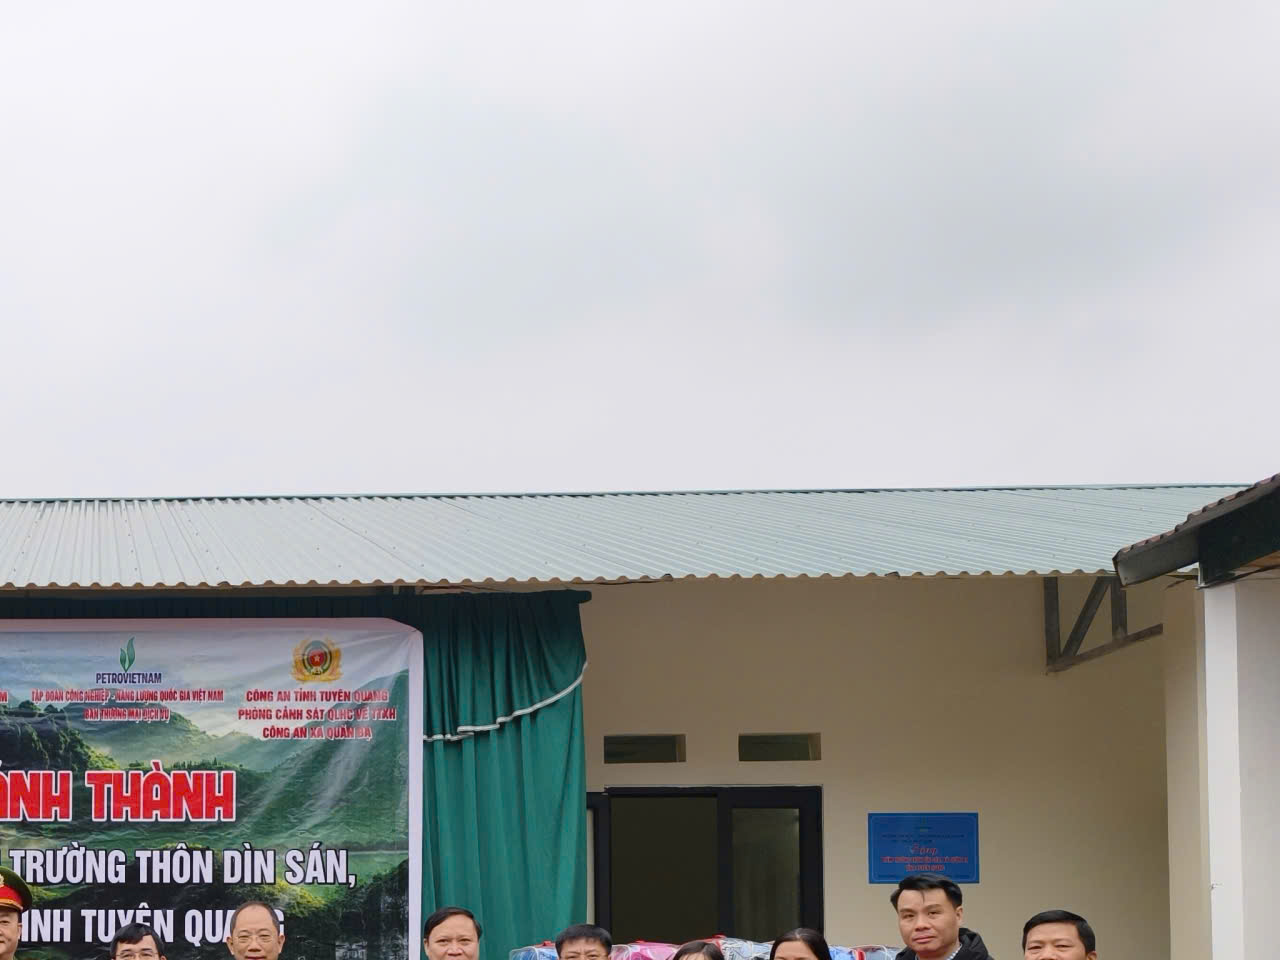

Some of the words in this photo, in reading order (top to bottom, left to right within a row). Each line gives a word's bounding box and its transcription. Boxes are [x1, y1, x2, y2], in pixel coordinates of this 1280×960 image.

[96, 672, 162, 684] PETROVIETNAM
[179, 689, 191, 701] GIA
[207, 689, 224, 701] NAM
[246, 689, 274, 702] CÔNG
[277, 690, 291, 702] AN
[319, 689, 351, 702] TUYÊN
[354, 690, 389, 703] QUANG
[262, 724, 290, 739] CÔNG
[293, 727, 307, 738] AN
[85, 759, 236, 822] THÀNH
[9, 842, 127, 884] TRƯỜNG
[135, 844, 214, 884] THÔN
[222, 842, 275, 884] DÌN
[284, 842, 356, 888] SÁN,
